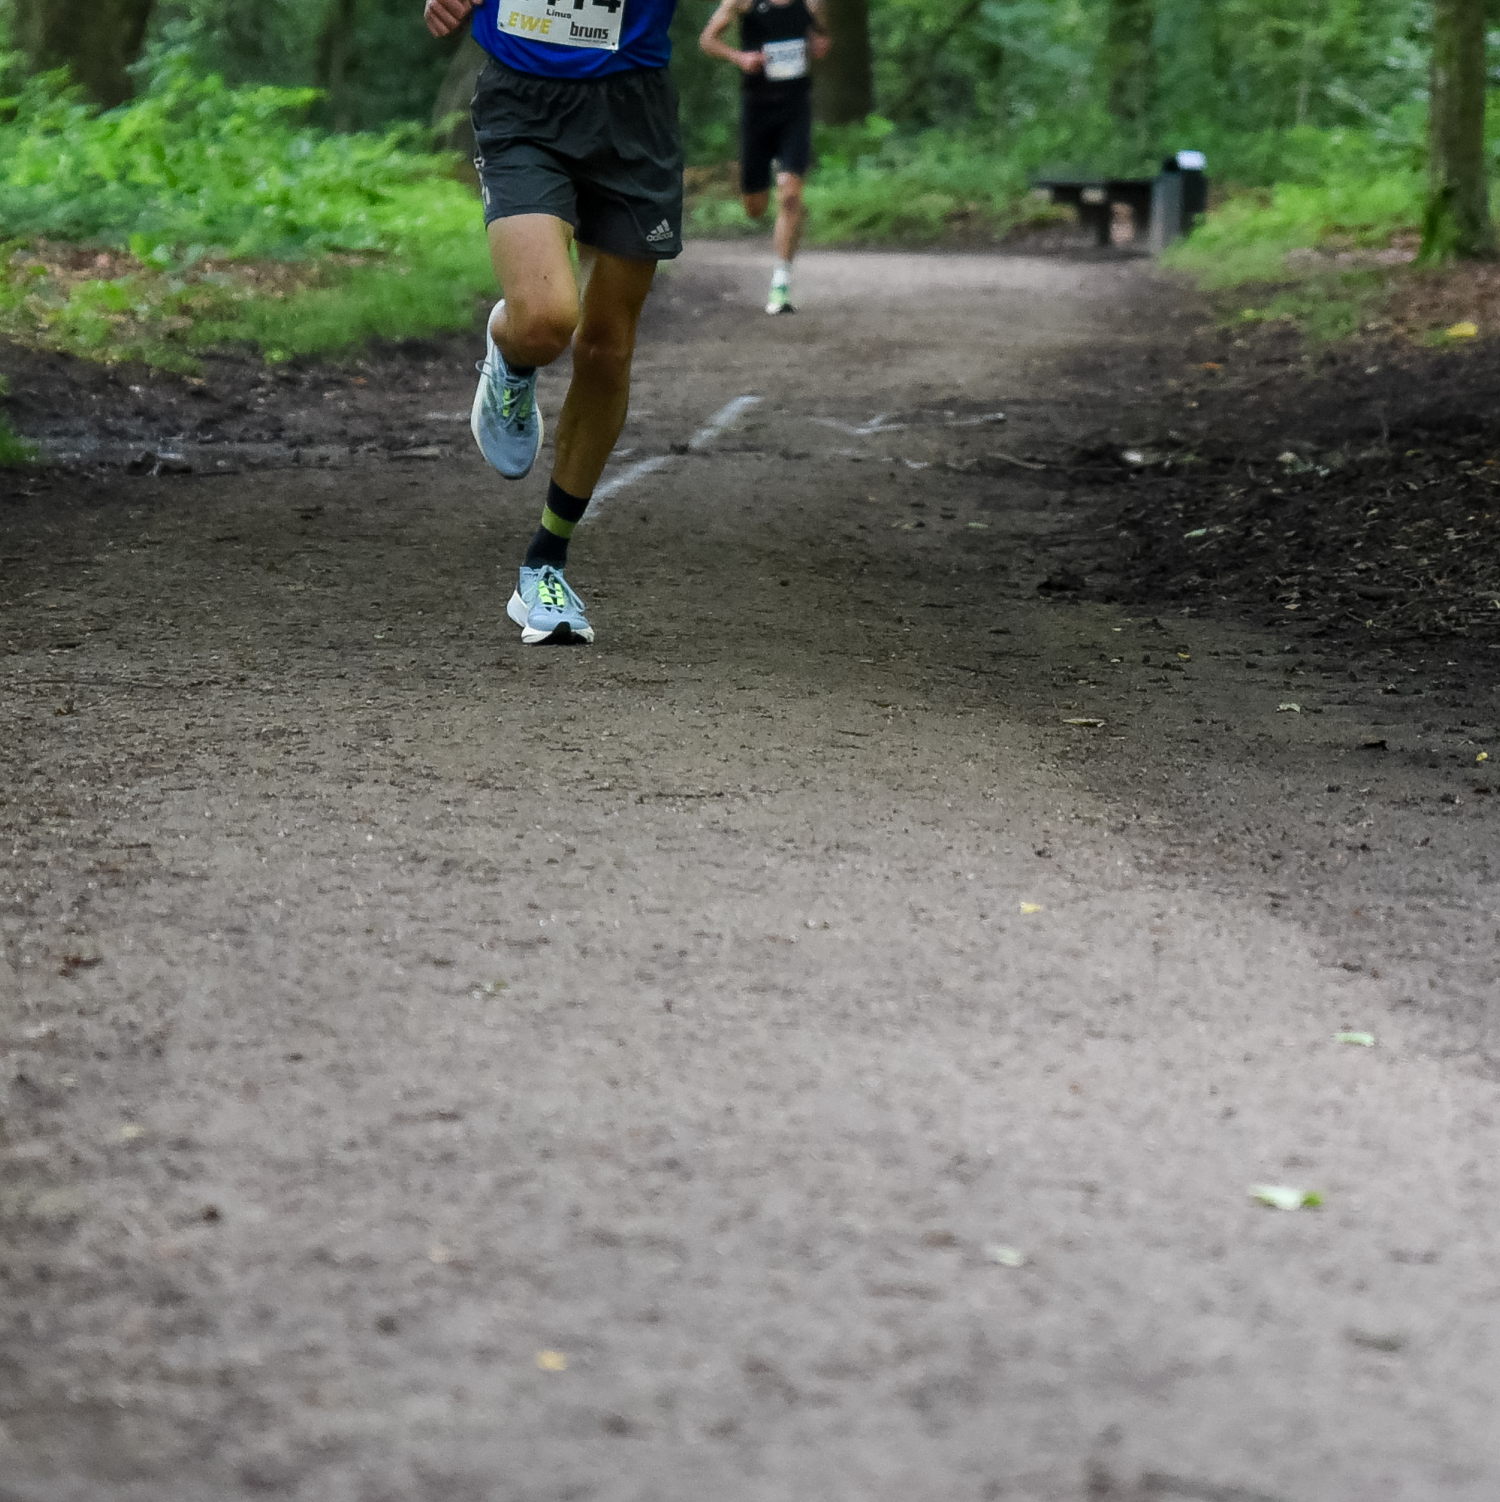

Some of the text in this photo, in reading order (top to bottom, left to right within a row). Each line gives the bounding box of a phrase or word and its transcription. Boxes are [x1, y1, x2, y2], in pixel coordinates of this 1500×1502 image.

[546, 9, 572, 19] Linus
[508, 11, 553, 34] EWE
[570, 21, 609, 40] bruns
[646, 231, 674, 242] adidas
